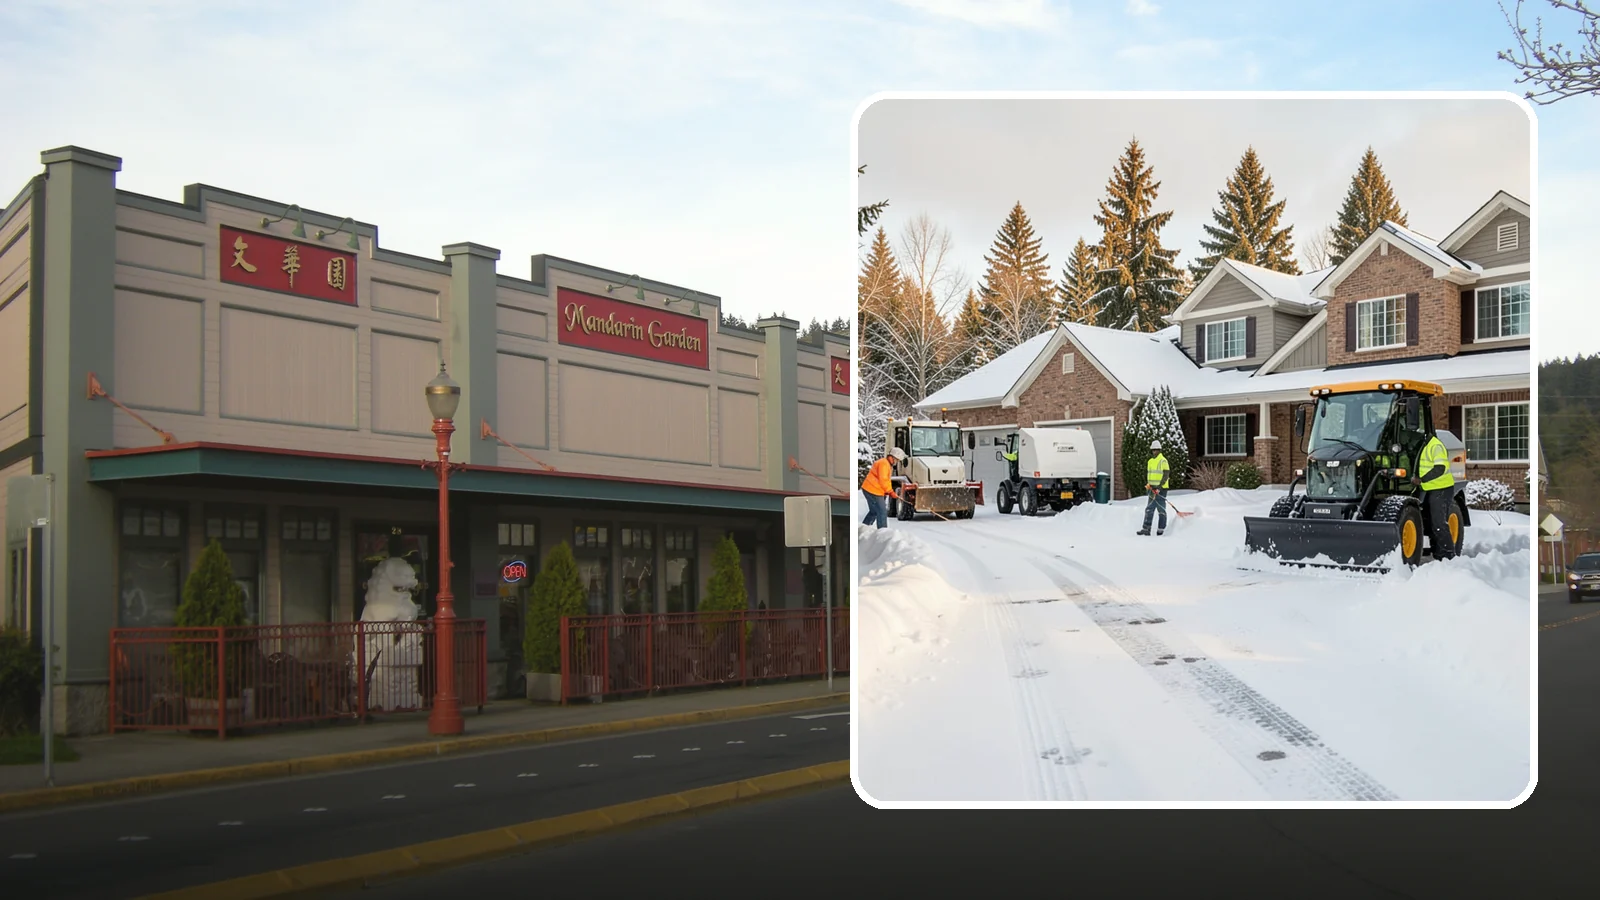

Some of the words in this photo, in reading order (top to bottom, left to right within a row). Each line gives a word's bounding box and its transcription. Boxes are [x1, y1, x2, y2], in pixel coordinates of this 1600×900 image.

[231, 235, 346, 291] 文華園
[564, 302, 644, 341] Mandarin
[648, 320, 701, 352] Garden
[503, 565, 527, 578] OPEN
